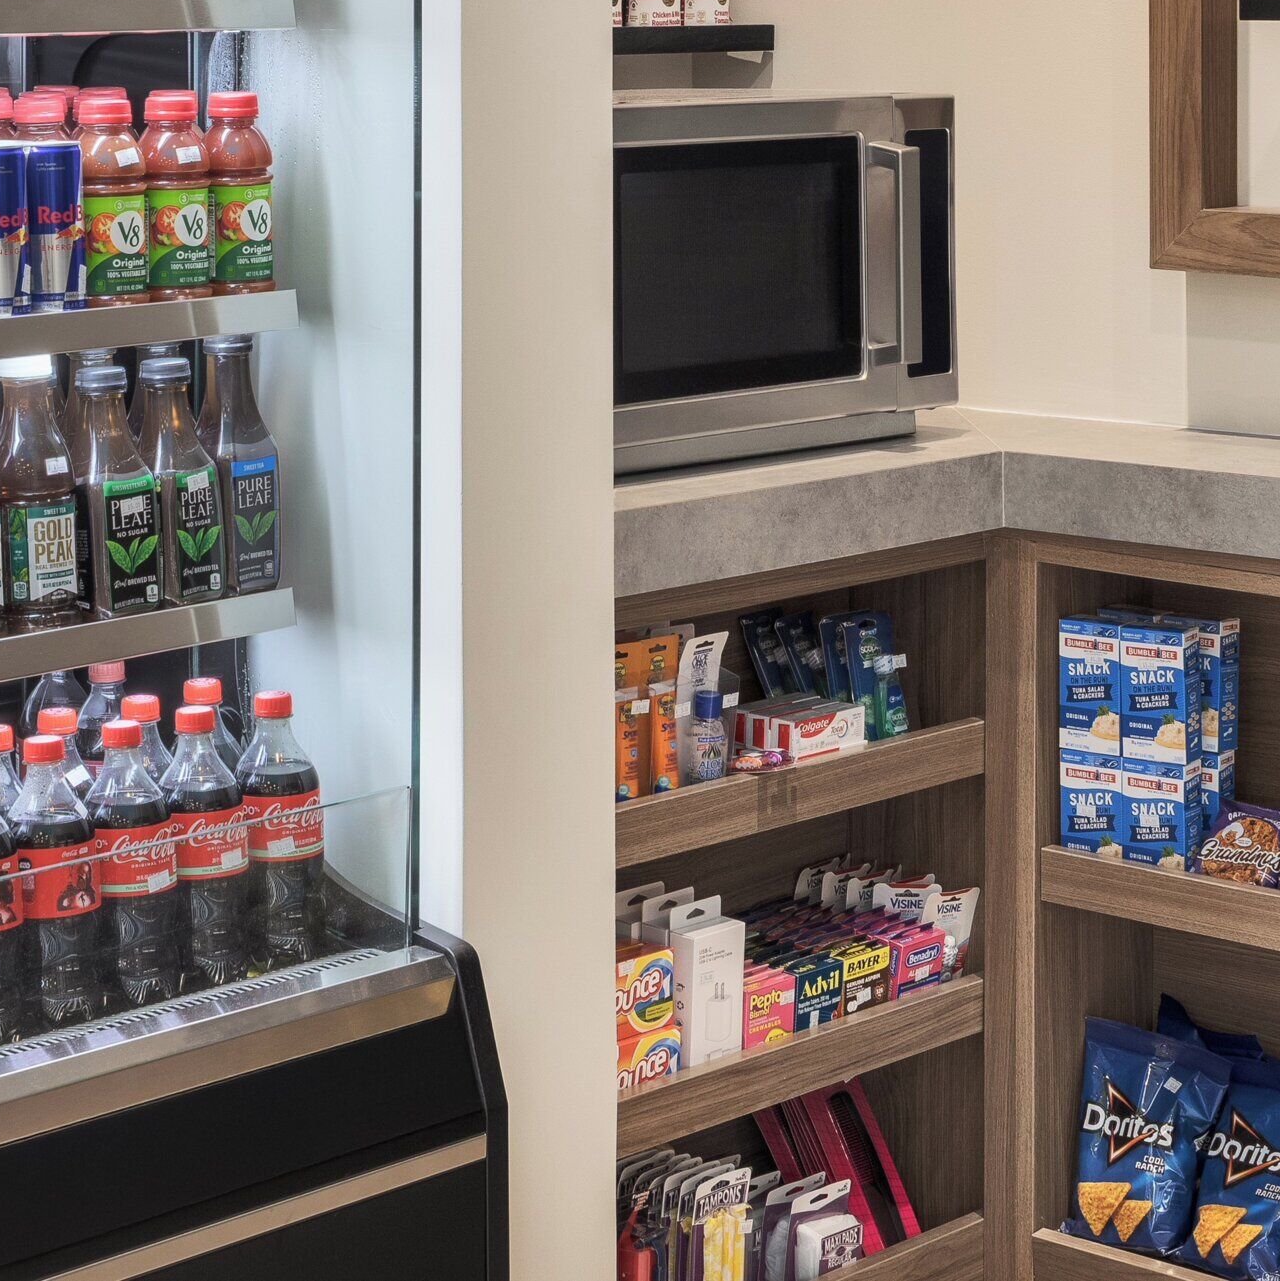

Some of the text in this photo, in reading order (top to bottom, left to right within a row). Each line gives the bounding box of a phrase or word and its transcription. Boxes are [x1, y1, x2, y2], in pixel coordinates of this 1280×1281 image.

[38, 205, 73, 224] Red
[248, 204, 267, 234] V8
[118, 217, 139, 247] V8
[182, 210, 203, 239] V8
[113, 258, 144, 268] Original
[177, 251, 207, 260] Original
[238, 476, 272, 494] PURE
[181, 487, 212, 505] PURE
[239, 490, 270, 508] LEAF
[183, 502, 213, 520] LEAF
[34, 517, 71, 542] GOLD
[128, 528, 148, 536] SUGAR
[35, 539, 73, 564] PEAK
[1066, 639, 1114, 651] BUMBLE BEE
[1128, 647, 1177, 660] BUMBLE BEE
[1068, 662, 1111, 675] SNACK
[1130, 670, 1175, 685] SNACK
[1078, 692, 1105, 700] CRACKERS
[799, 718, 829, 733] Colgate
[1066, 712, 1089, 721] ORIGINAL
[890, 898, 924, 909] VISINE
[937, 902, 962, 913] VISINE
[848, 954, 880, 973] BAYER
[909, 945, 939, 964] Benadryl
[801, 970, 839, 999] Advil
[750, 989, 782, 1010] Pepto
[1083, 1102, 1175, 1148] Doritos
[699, 1186, 742, 1216] TAMPONS
